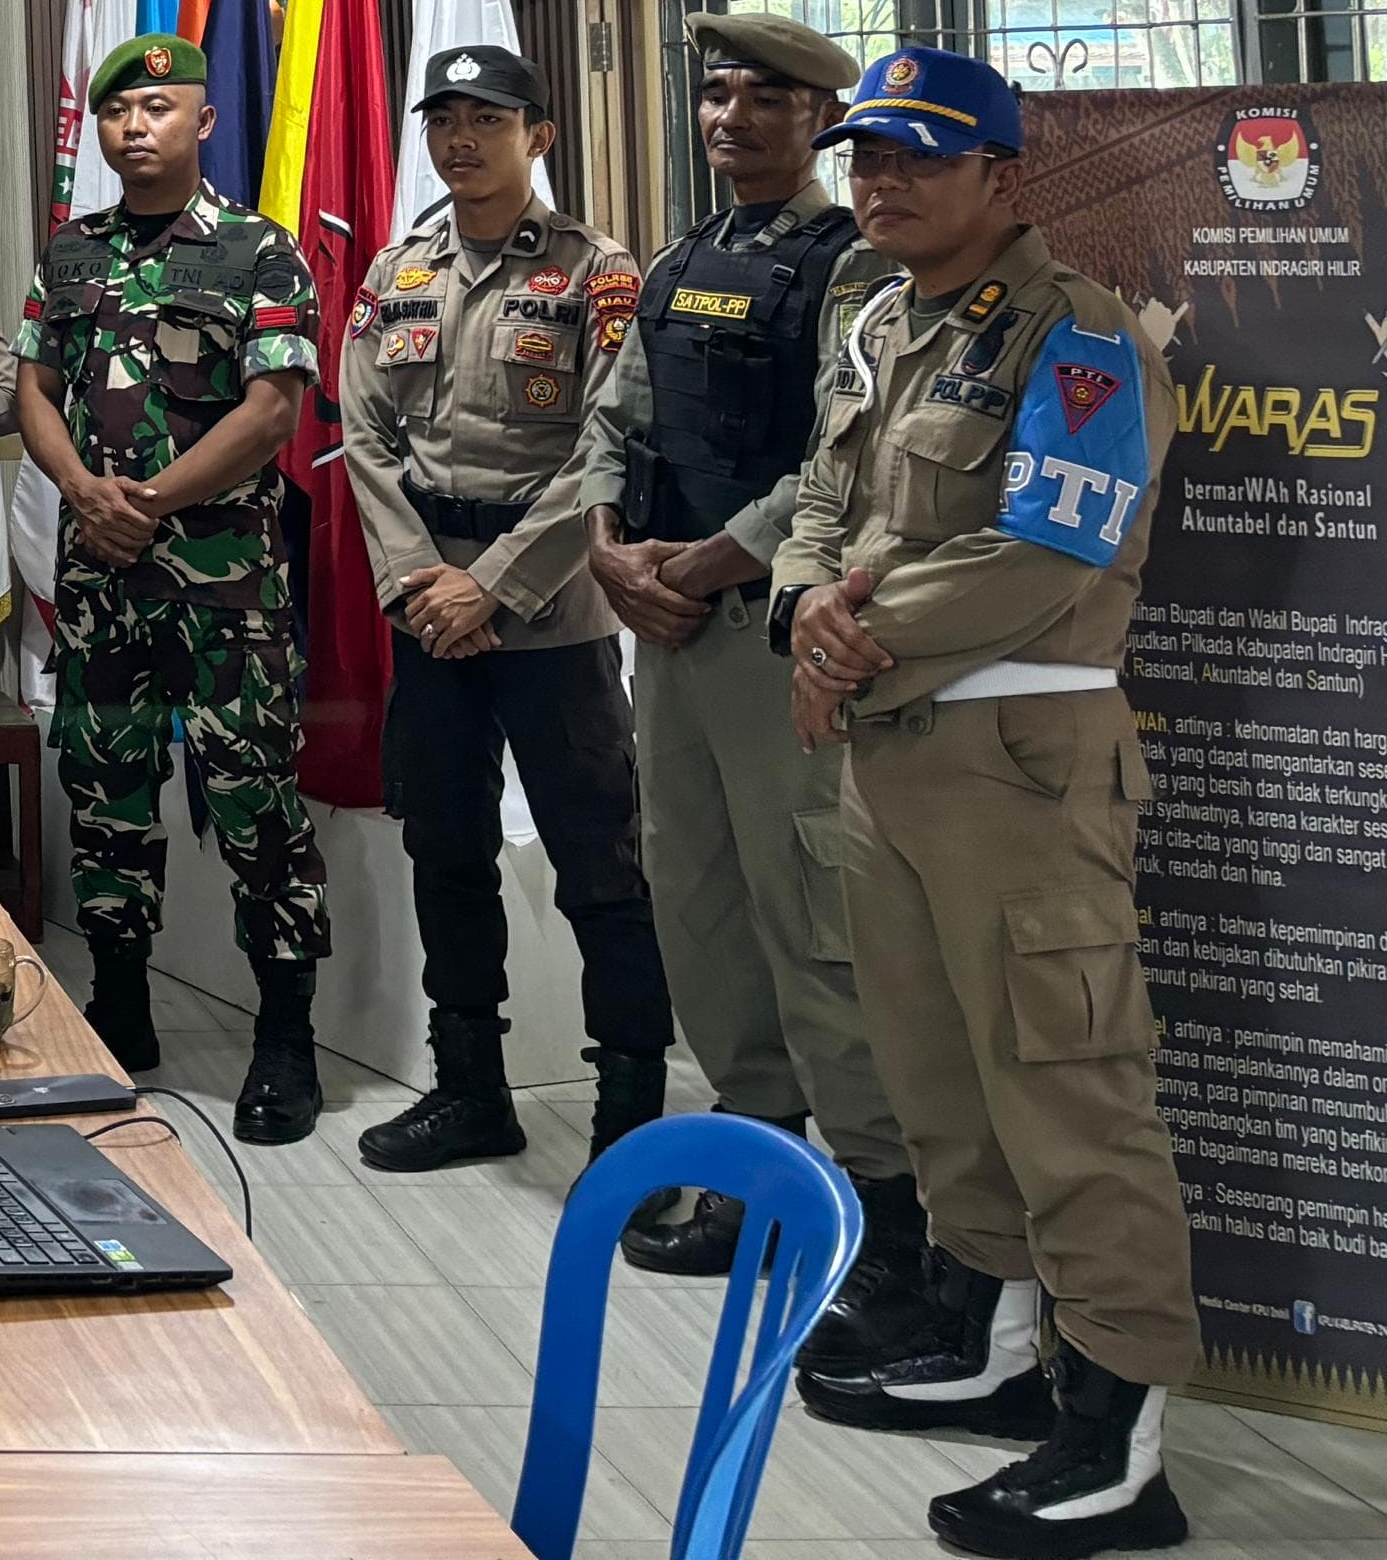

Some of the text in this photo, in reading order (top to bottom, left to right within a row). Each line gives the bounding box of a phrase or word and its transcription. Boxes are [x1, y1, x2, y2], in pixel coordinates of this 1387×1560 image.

[1236, 107, 1298, 120] KOMISI
[1217, 164, 1320, 211] PEMILIHAN UMUM
[1193, 227, 1349, 244] KOMISI PEMILIHAN UMUM
[172, 270, 202, 285] TNI
[1184, 260, 1361, 277] KABUPATEN INDRAGIRI HILIR
[503, 298, 578, 325] POLRI
[597, 297, 632, 308] RIAU
[676, 293, 746, 314] SATPOL-PP
[1071, 367, 1104, 383] PTI
[930, 378, 1006, 410] POL PP
[1177, 365, 1379, 458] WARAS
[999, 451, 1139, 546] PTI
[1184, 476, 1372, 507] bermarWAh Rasional
[1181, 506, 1377, 540] Akuntabel dan Santun
[1171, 603, 1215, 630] Bupati
[1218, 607, 1245, 628] dan
[1248, 608, 1287, 631] Wakil
[1291, 611, 1337, 638] Bupati
[1182, 632, 1233, 656] Pilkada
[1237, 636, 1313, 663] Kabupaten
[1317, 640, 1377, 670] Indragiri
[1201, 662, 1272, 687] Akuntabel
[1276, 670, 1303, 690] dan
[1306, 669, 1364, 699] Santun)
[1175, 715, 1223, 740] artinya
[1234, 719, 1319, 742] kehormatan
[1323, 725, 1351, 747] dan
[1170, 747, 1204, 769] yang
[1208, 746, 1249, 771] dapat
[1252, 752, 1354, 777] mengantarkan
[1171, 776, 1205, 798] yang
[1209, 774, 1252, 797] bersih
[1256, 778, 1283, 800] dan
[1287, 781, 1321, 804] tidak
[1157, 800, 1244, 829] syahwatnya,
[1247, 806, 1296, 830] karena
[1300, 811, 1360, 836] karakter
[1166, 828, 1220, 851] cita-cita
[1224, 837, 1258, 860] yang
[1262, 836, 1301, 864] tinggi
[1304, 841, 1332, 863] dan
[1336, 846, 1387, 872] sangat
[1168, 858, 1217, 881] rendah
[1221, 862, 1248, 883] dan
[1251, 865, 1287, 888] hina.
[1160, 909, 1377, 952] artinya bahwa kepemimpinan
[1163, 936, 1190, 958] dan
[1193, 938, 1260, 968] kebijakan
[1264, 947, 1343, 977] dibutuhkan
[1190, 967, 1236, 993] pikiran
[1240, 979, 1276, 1004] yang
[1279, 979, 1324, 1004] sehat.
[1174, 1019, 1223, 1046] artinya
[1234, 1027, 1304, 1056] pemimpin
[1203, 1053, 1319, 1089] menjalankannya
[1323, 1066, 1369, 1092] dalam
[1206, 1083, 1239, 1104] para
[1242, 1085, 1308, 1112] pimpinan
[1275, 1117, 1297, 1141] tim
[1301, 1125, 1337, 1152] yang
[1171, 1135, 1196, 1156] dan
[1199, 1136, 1278, 1168] bagaimana
[1282, 1152, 1337, 1176] mereka
[1215, 1182, 1294, 1219] Seseorang
[1297, 1199, 1370, 1228] pemimpin
[1225, 1213, 1264, 1239] halus
[1267, 1221, 1296, 1244] dan
[1299, 1225, 1330, 1250] baik
[1333, 1230, 1366, 1255] budi
